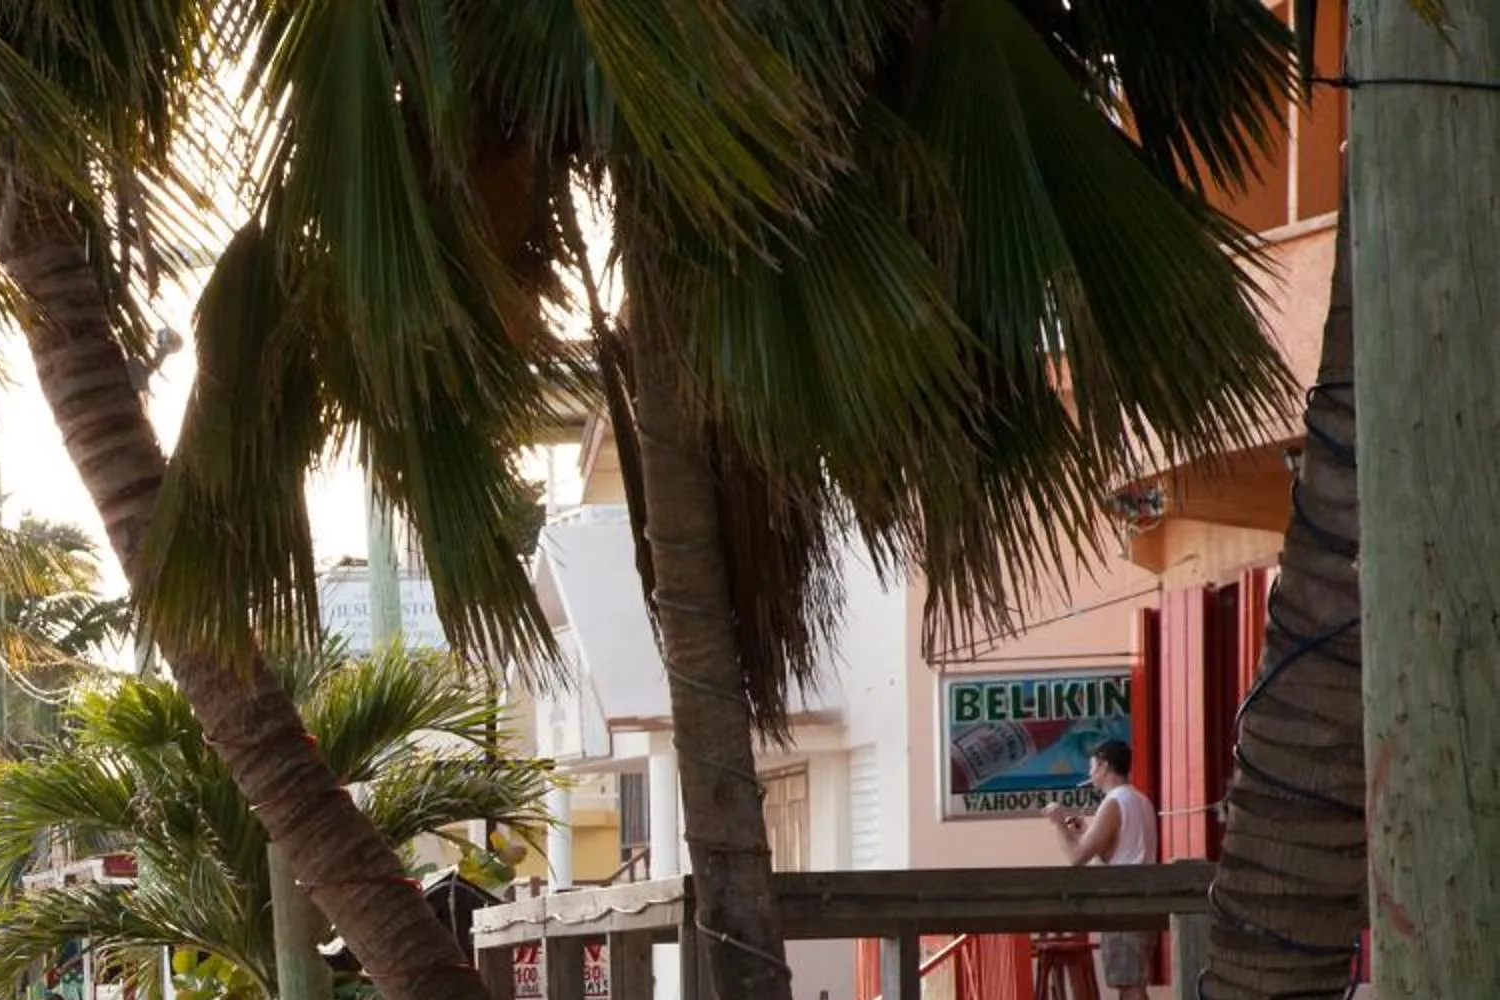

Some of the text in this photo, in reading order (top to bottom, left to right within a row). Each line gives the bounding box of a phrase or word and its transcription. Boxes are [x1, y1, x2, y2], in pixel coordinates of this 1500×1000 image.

[953, 678, 1132, 723] BELIKIN
[963, 788, 1106, 812] WAHOO'S LOUN
